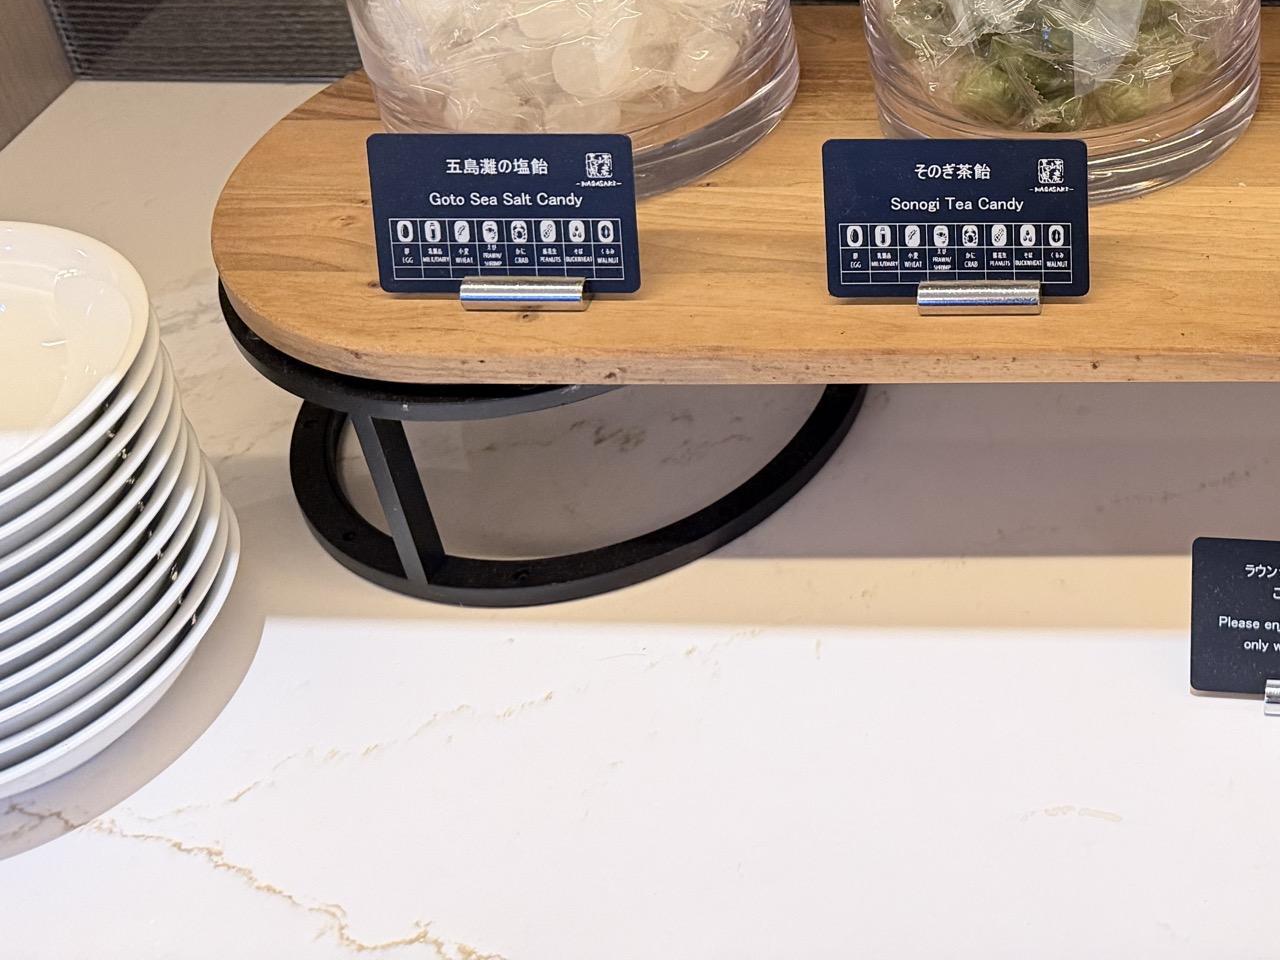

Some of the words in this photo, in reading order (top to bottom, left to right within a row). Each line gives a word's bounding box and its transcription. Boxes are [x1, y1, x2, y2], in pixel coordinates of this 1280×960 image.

[446, 158, 548, 175] 五島灘の塩飴
[914, 163, 991, 179] そのぎ茶飴
[429, 193, 465, 206] Goto
[470, 193, 498, 206] Sea
[503, 193, 532, 206] Salt
[537, 193, 583, 207] Candy
[891, 197, 939, 212] Sonogi
[945, 197, 972, 210] Tea
[978, 197, 1024, 212] Candy
[1219, 616, 1260, 629] Please
[1243, 640, 1269, 653] only
